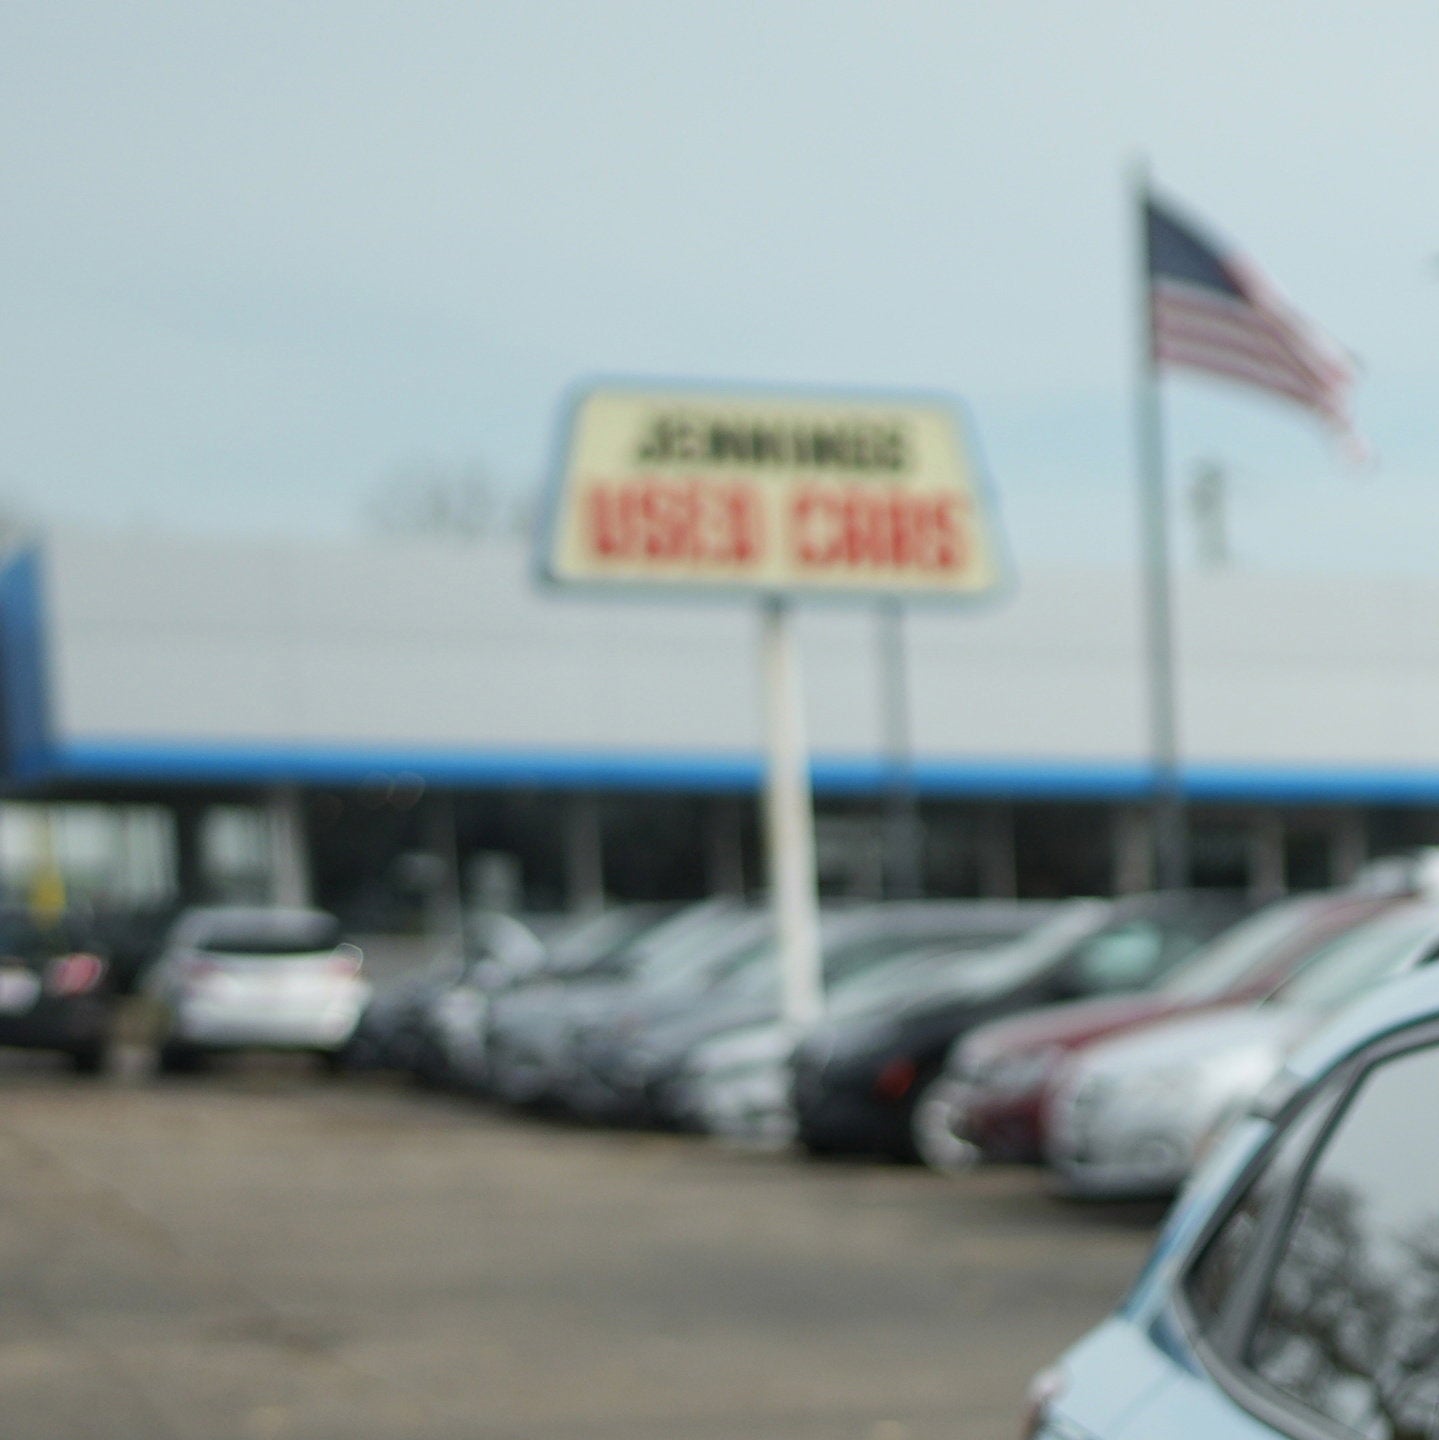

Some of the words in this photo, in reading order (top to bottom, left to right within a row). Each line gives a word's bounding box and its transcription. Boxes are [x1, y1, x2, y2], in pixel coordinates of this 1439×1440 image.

[638, 413, 906, 471] JENNINGS
[588, 484, 760, 564] USED
[794, 488, 966, 572] CARS
